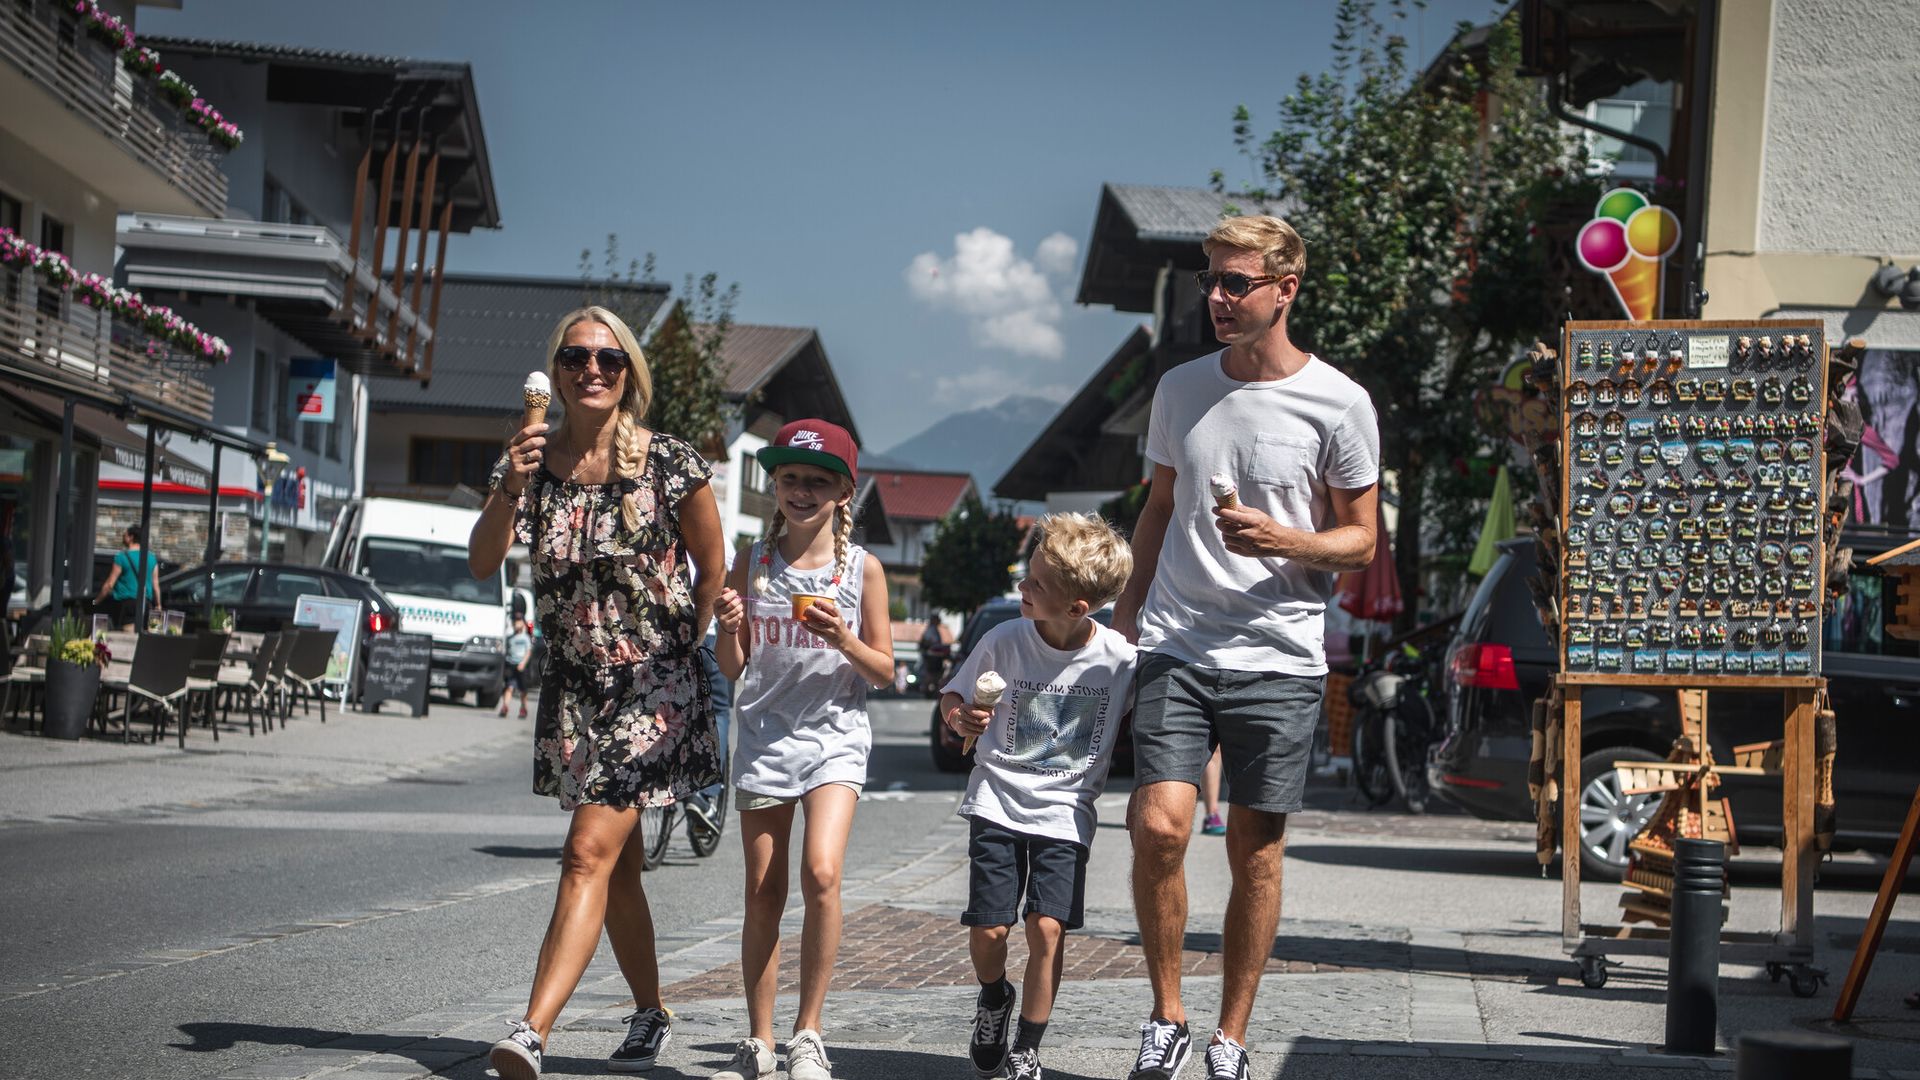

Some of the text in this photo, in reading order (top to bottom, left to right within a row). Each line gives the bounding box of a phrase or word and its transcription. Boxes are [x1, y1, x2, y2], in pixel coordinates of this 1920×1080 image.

[795, 430, 819, 440] NIKE
[808, 442, 823, 451] SB
[752, 614, 853, 649] TOTAL
[1013, 679, 1110, 697] VOLCOM STONE
[1096, 695, 1111, 727] TRUE
[1004, 732, 1014, 755] RUE
[1090, 727, 1104, 745] TO
